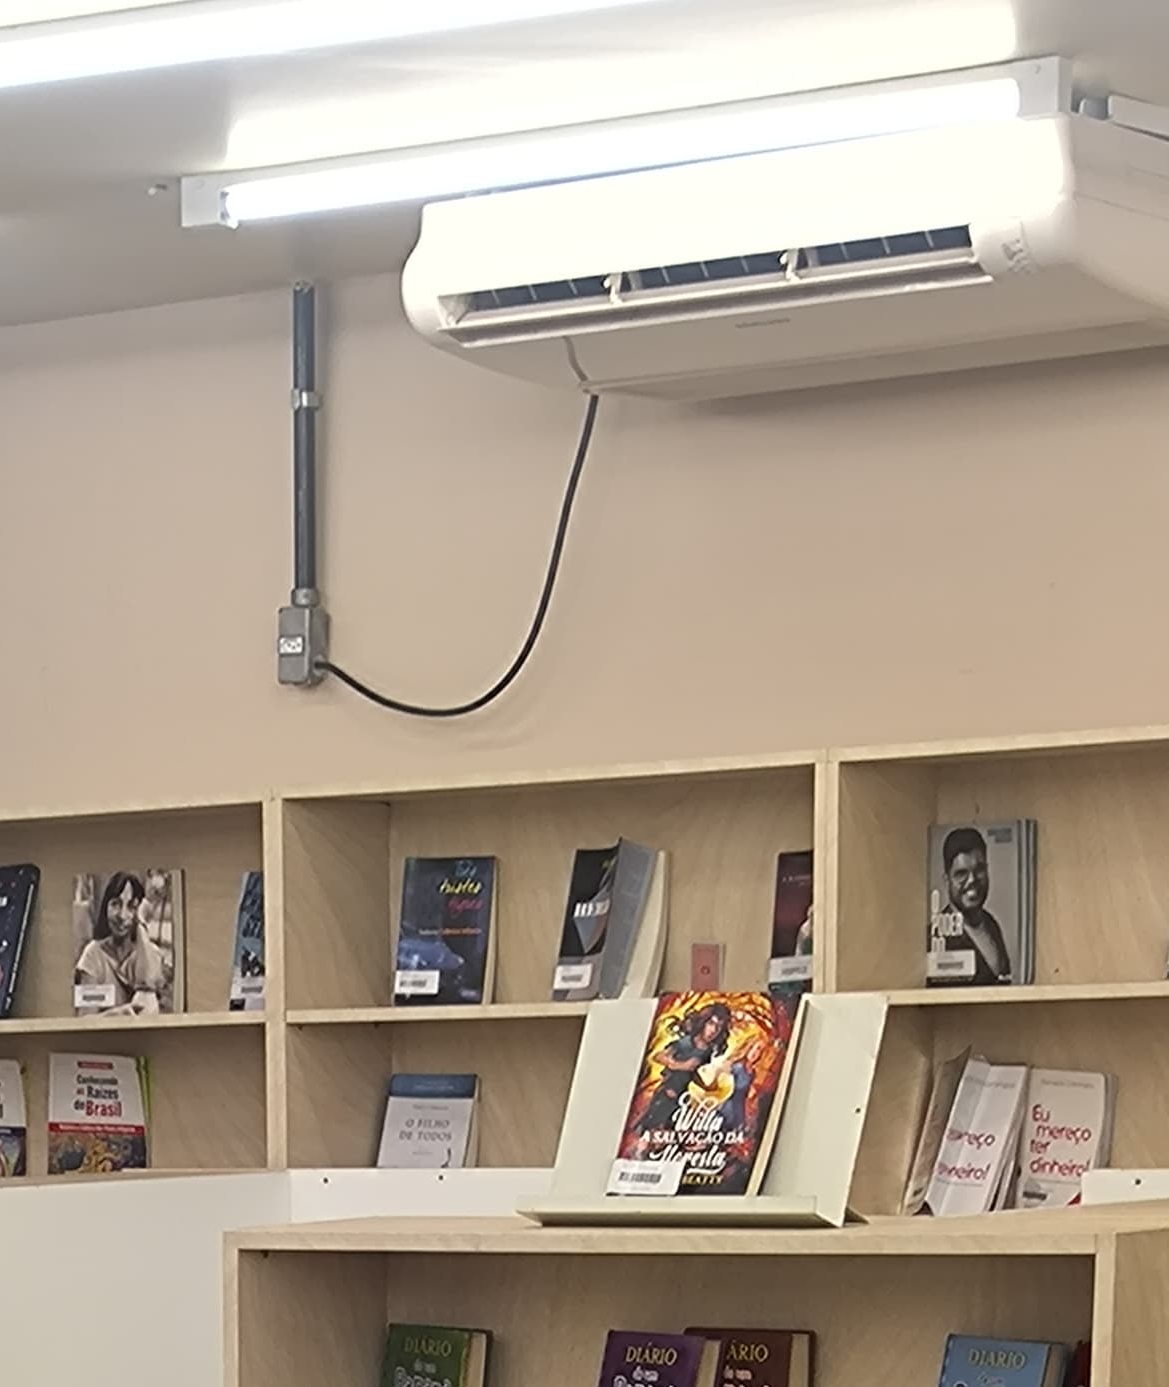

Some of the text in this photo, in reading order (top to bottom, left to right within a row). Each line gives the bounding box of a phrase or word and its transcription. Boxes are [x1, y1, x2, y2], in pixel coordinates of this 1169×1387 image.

[931, 911, 964, 937] PODER
[85, 1099, 122, 1118] Brasil
[1031, 1103, 1051, 1123] Eu
[417, 1130, 452, 1142] TODOS
[1035, 1123, 1092, 1145] mereço
[625, 1341, 678, 1366] DIÁRIO
[726, 1338, 770, 1364] ÁRIO
